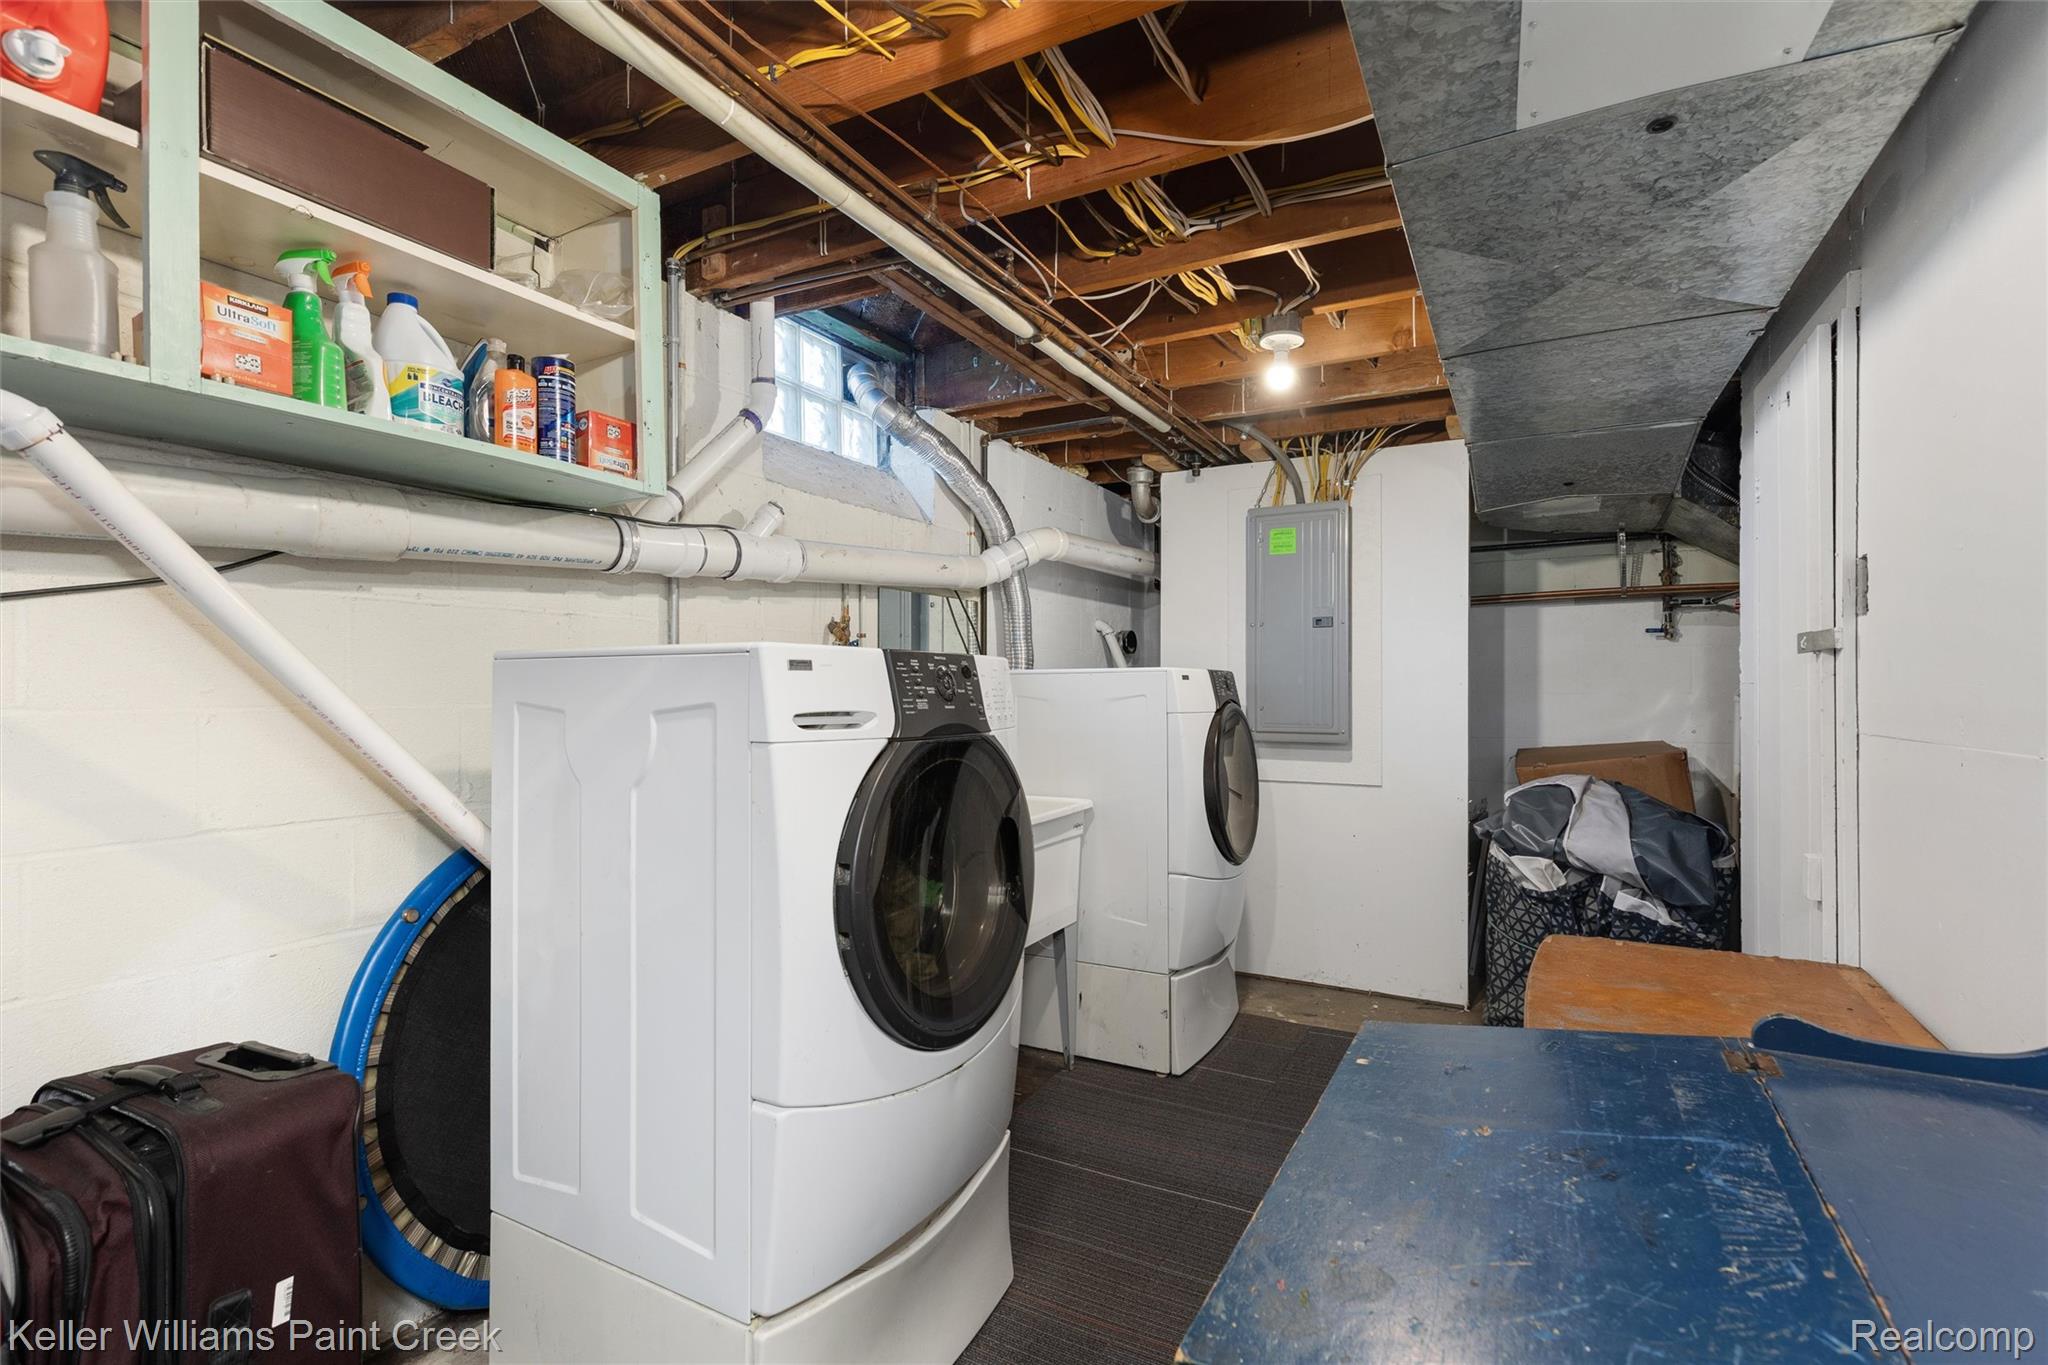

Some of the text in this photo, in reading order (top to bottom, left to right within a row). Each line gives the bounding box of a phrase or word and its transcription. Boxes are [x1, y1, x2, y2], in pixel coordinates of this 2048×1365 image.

[228, 296, 268, 313] KIRKLAND
[217, 304, 277, 332] UltraSoft
[422, 391, 464, 412] BLEACH
